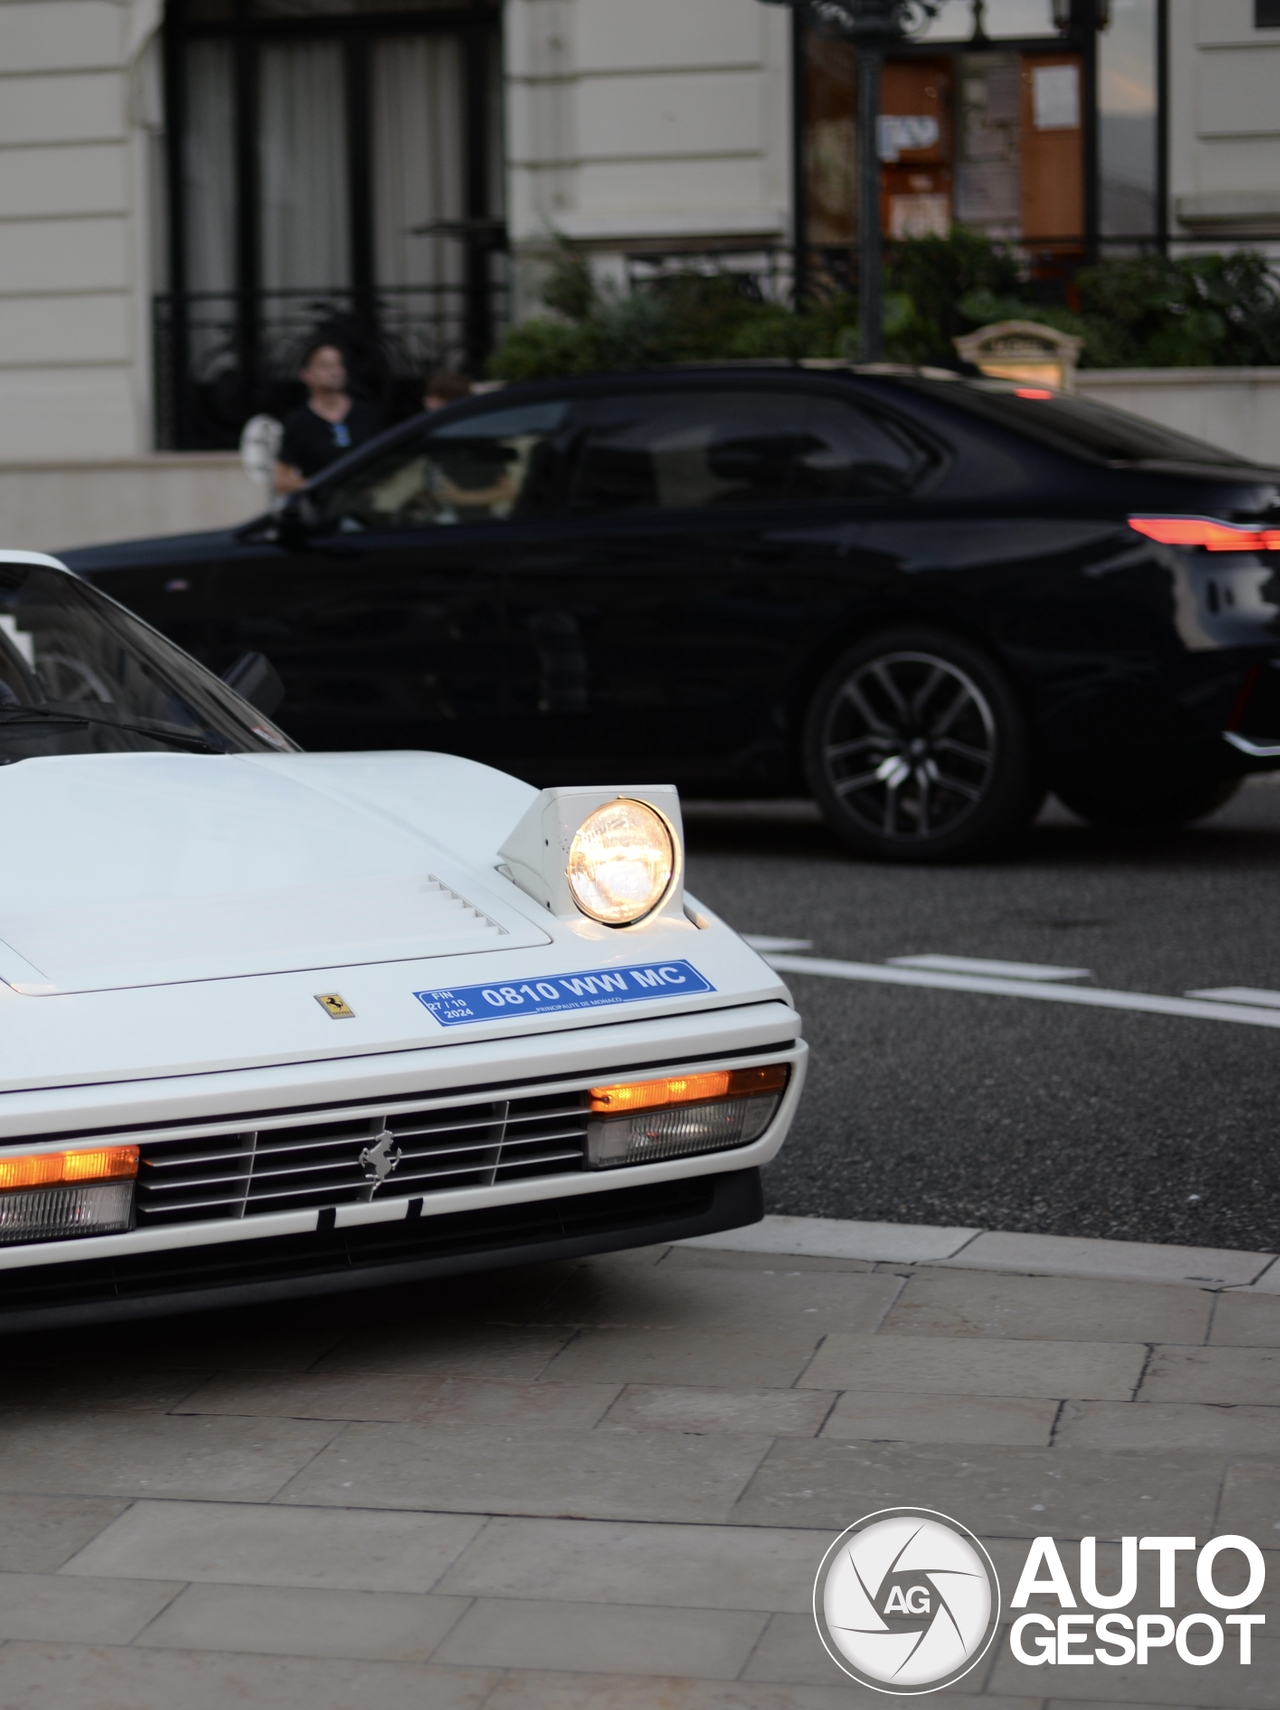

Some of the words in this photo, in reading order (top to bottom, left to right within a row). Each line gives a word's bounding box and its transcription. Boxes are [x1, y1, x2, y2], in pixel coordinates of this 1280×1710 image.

[481, 982, 560, 1007] 0810
[559, 972, 628, 996] WW
[629, 966, 686, 988] MC
[431, 991, 454, 1000] FIN
[428, 1002, 441, 1011] 27
[451, 999, 467, 1008] 10
[592, 997, 623, 1006] MONACO
[444, 1008, 474, 1019] 2024
